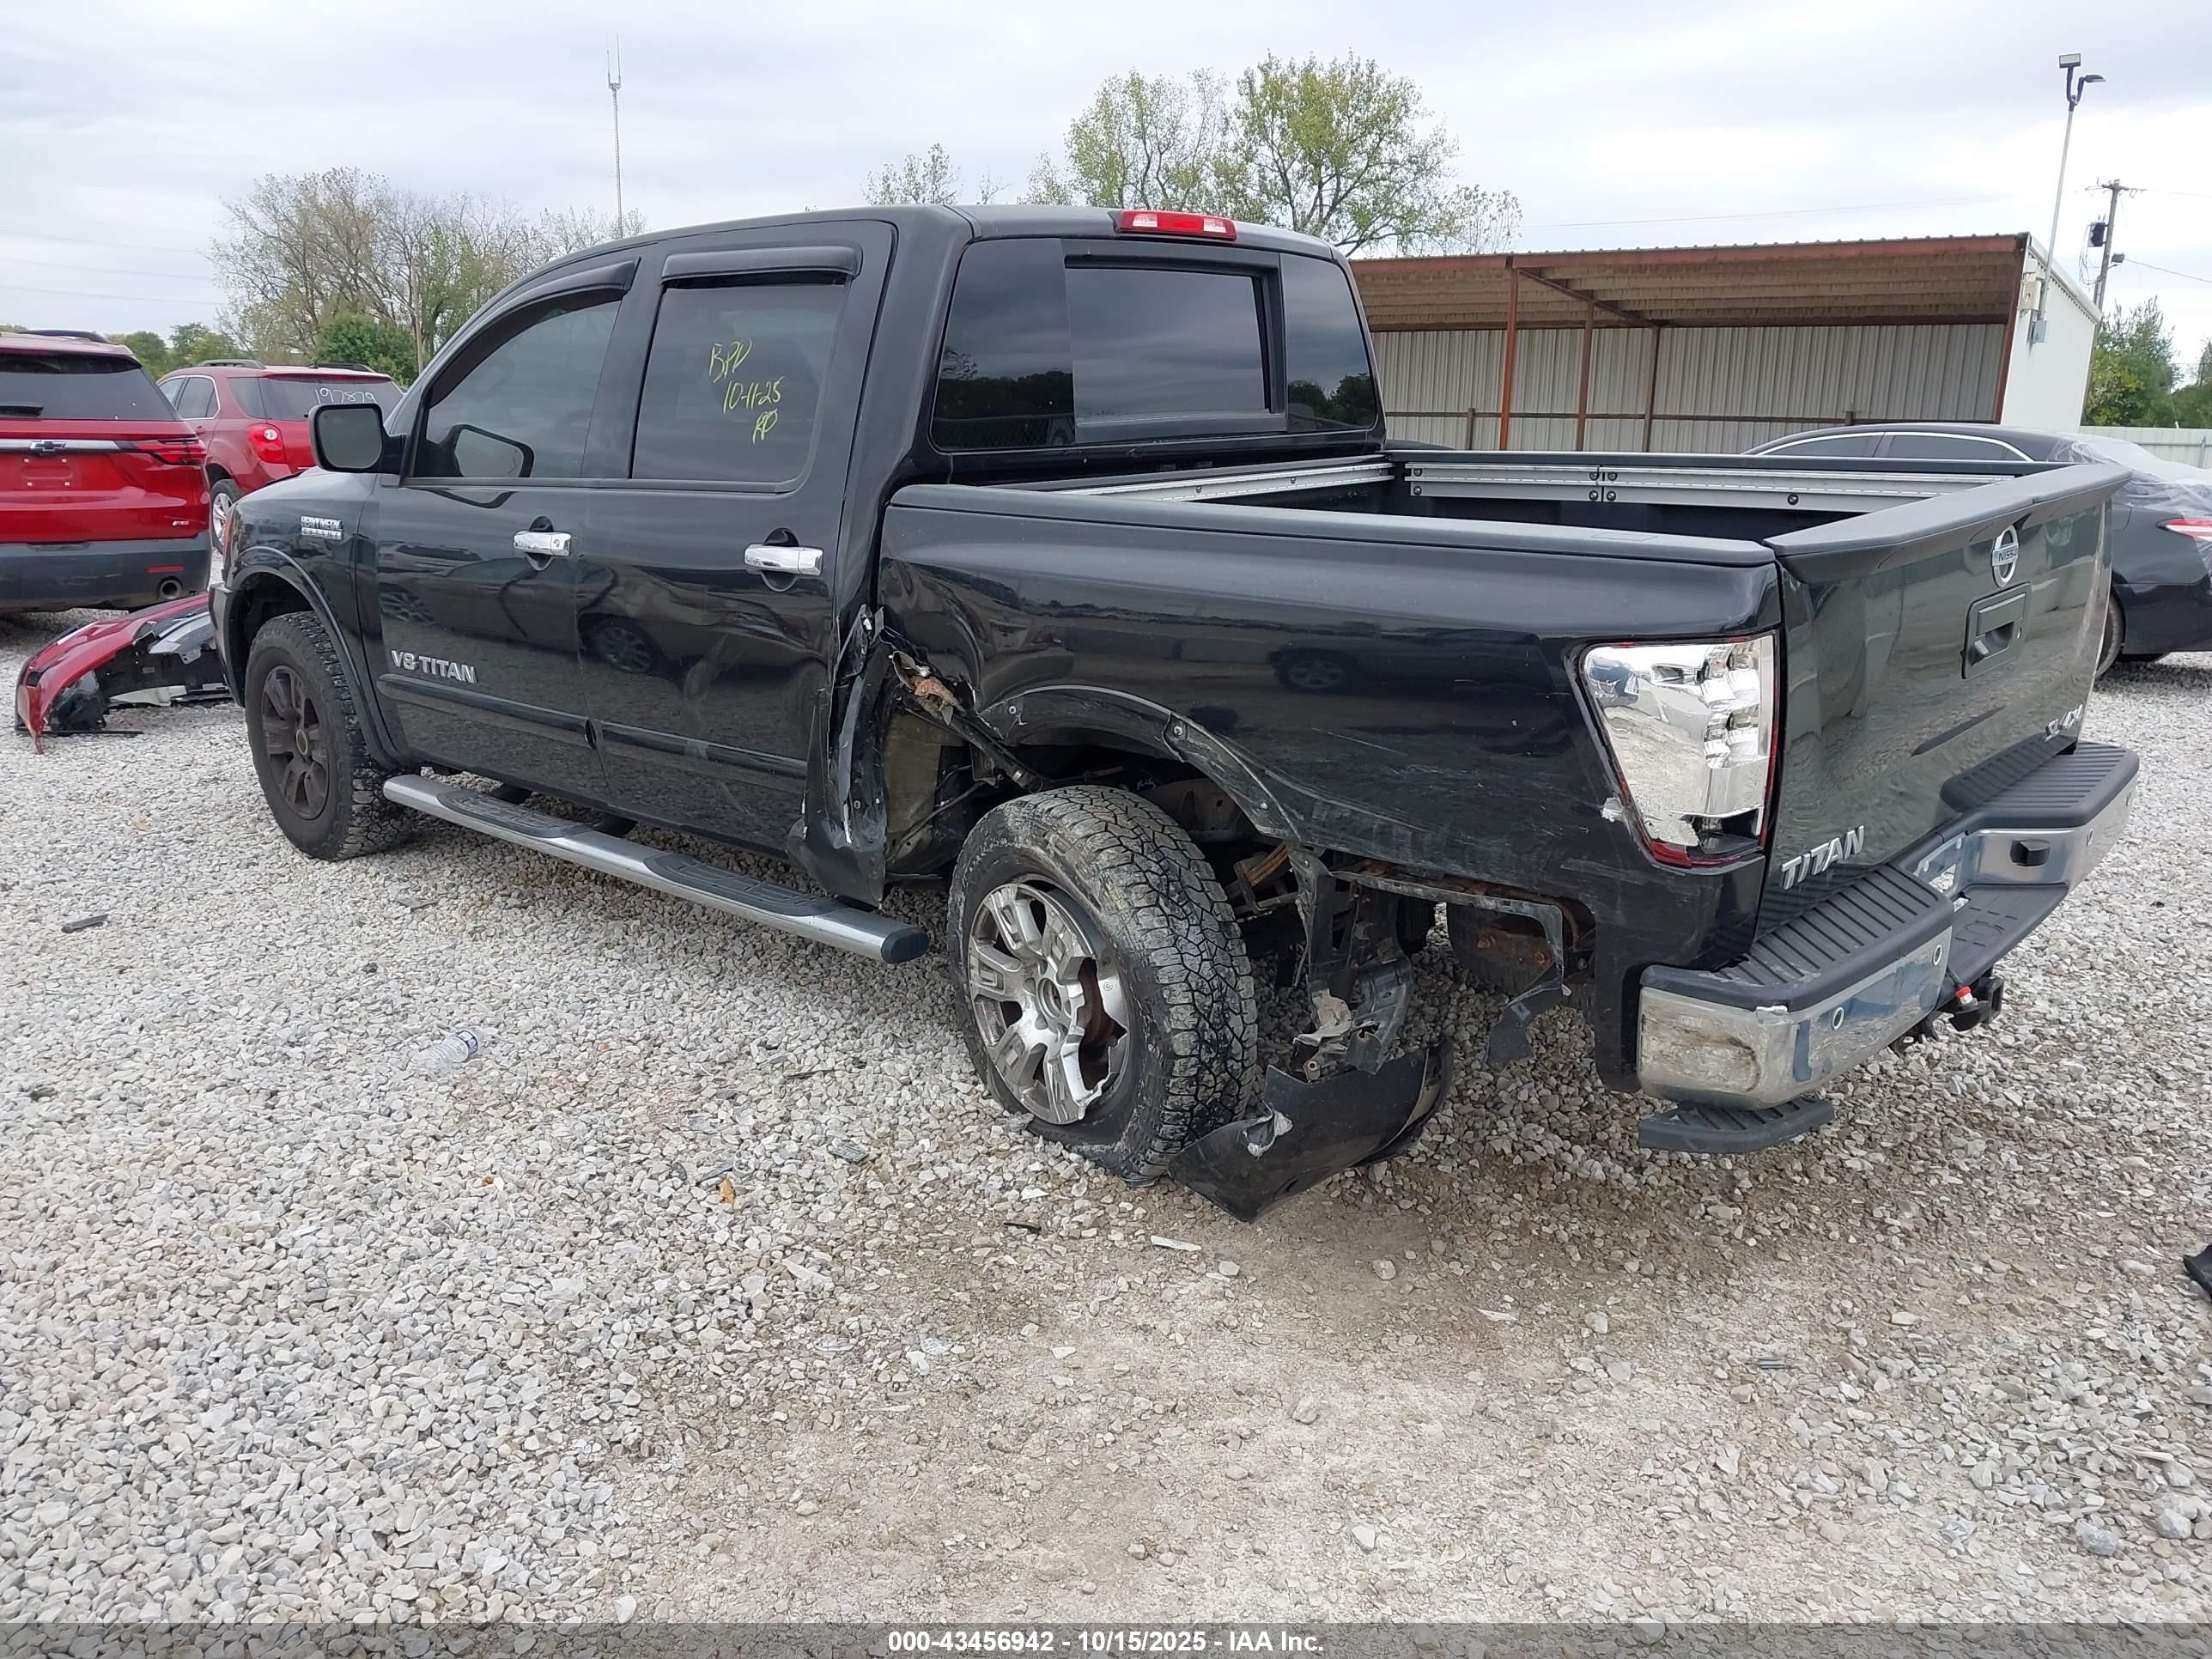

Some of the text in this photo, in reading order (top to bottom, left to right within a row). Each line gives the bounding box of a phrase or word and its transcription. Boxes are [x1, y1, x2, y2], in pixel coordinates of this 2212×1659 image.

[315, 387, 378, 404] 197879
[723, 375, 786, 415] 10-11-25
[1781, 825, 1864, 890] TITAN
